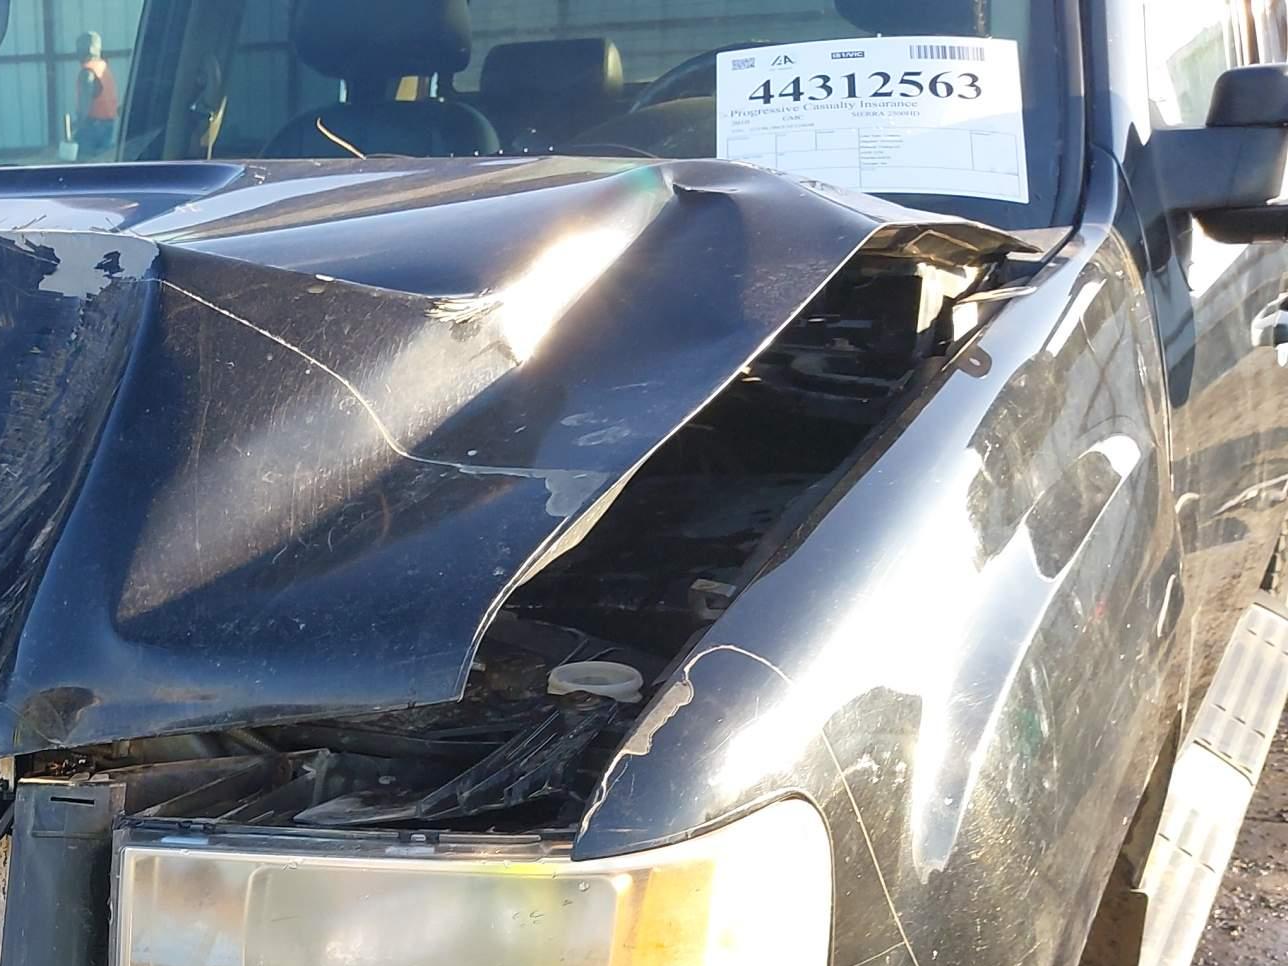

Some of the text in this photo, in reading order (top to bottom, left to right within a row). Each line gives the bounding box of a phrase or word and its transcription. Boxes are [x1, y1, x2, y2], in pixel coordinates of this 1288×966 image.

[748, 71, 982, 105] 44312563
[730, 99, 918, 119] Progressive Casualty Insurance
